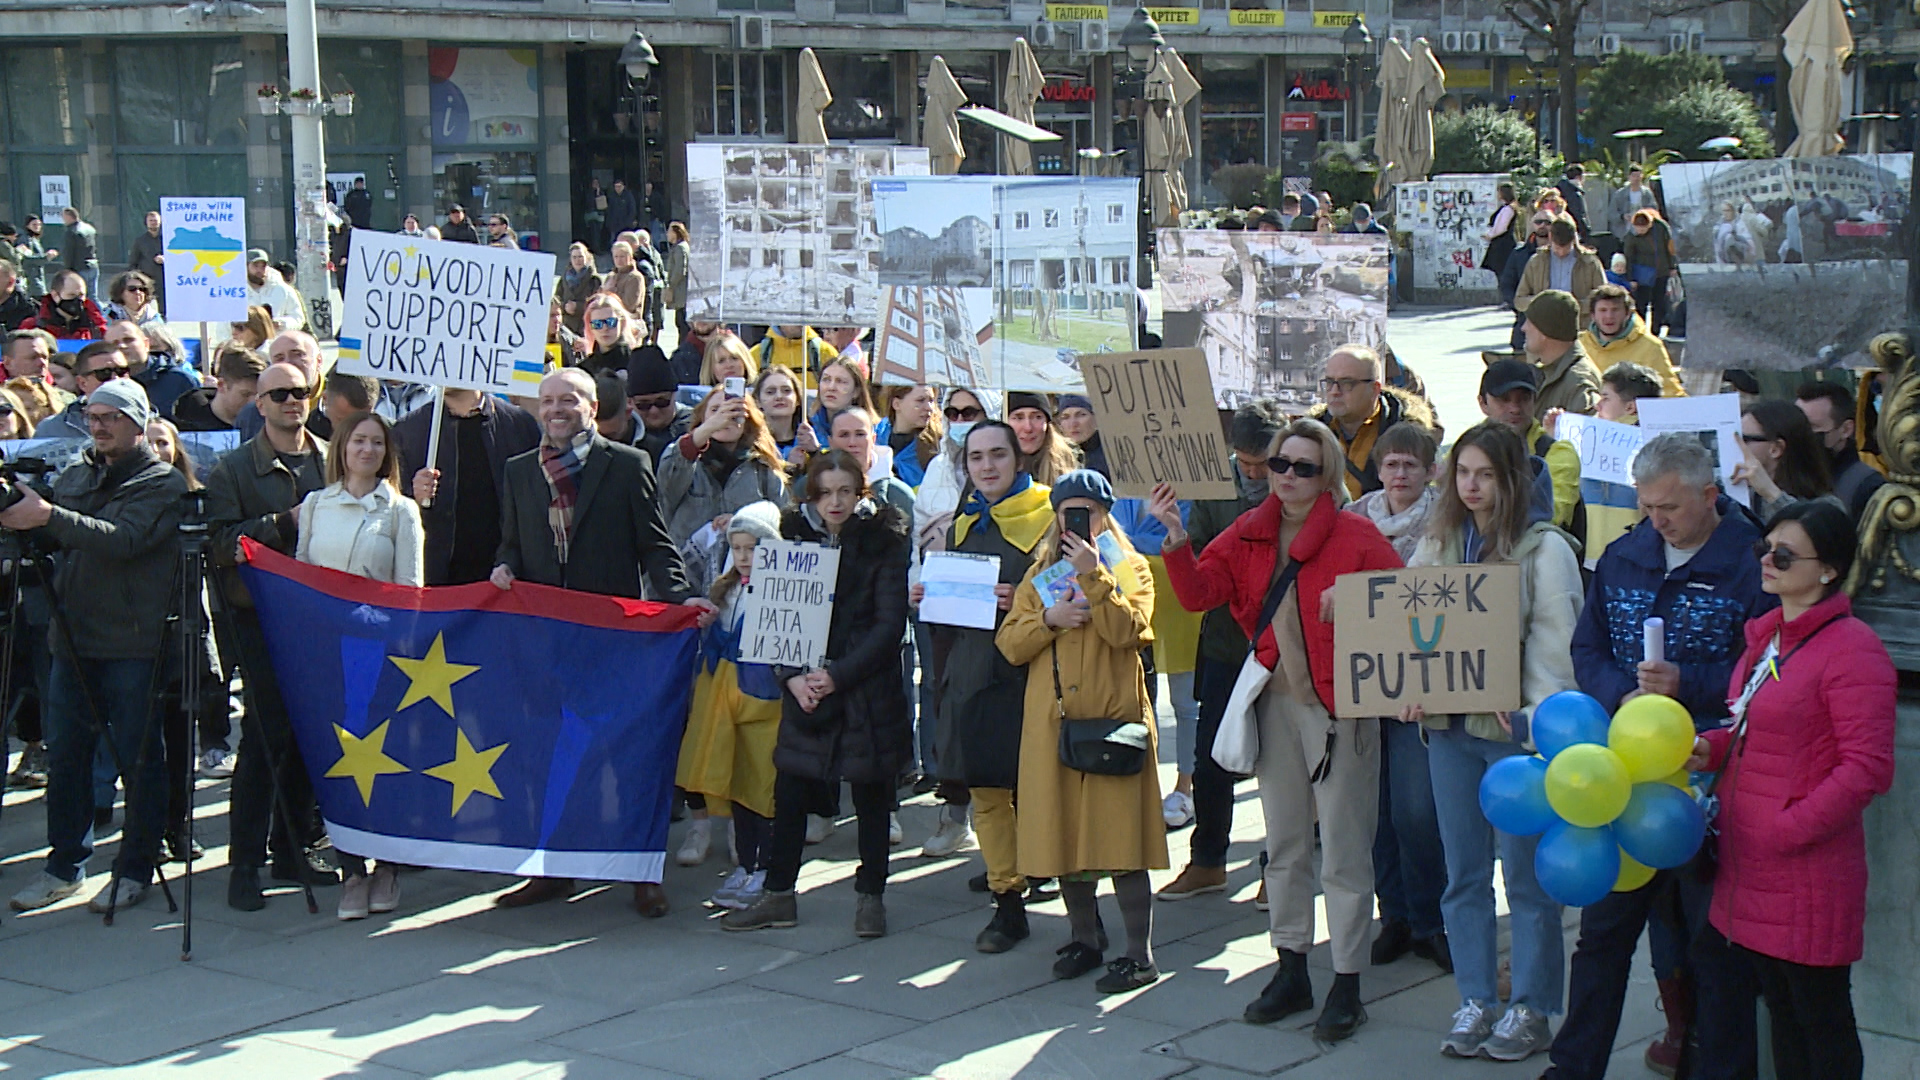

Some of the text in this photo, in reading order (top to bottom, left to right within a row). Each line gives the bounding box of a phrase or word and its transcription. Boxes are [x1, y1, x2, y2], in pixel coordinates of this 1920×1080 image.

[1055, 7, 1103, 20] ГАЛЕРИЈА
[1238, 13, 1276, 24] GALLERY
[1323, 15, 1354, 26] ARTGE
[207, 201, 232, 210] WITH
[176, 275, 208, 286] SAVE
[360, 245, 545, 306] VOJVODINA
[364, 288, 527, 349] SUPPORTS
[366, 332, 514, 388] UKRAINE
[1093, 359, 1187, 415] PUTIN
[1142, 411, 1182, 433] IS A
[1104, 431, 1233, 484] WAR CRIMINAL
[757, 547, 778, 571] ЗА
[762, 577, 824, 606] ПРОТИВ
[758, 607, 802, 634] РАТА
[752, 634, 812, 663] И ЗЛА!
[1350, 649, 1486, 704] PUTIN
